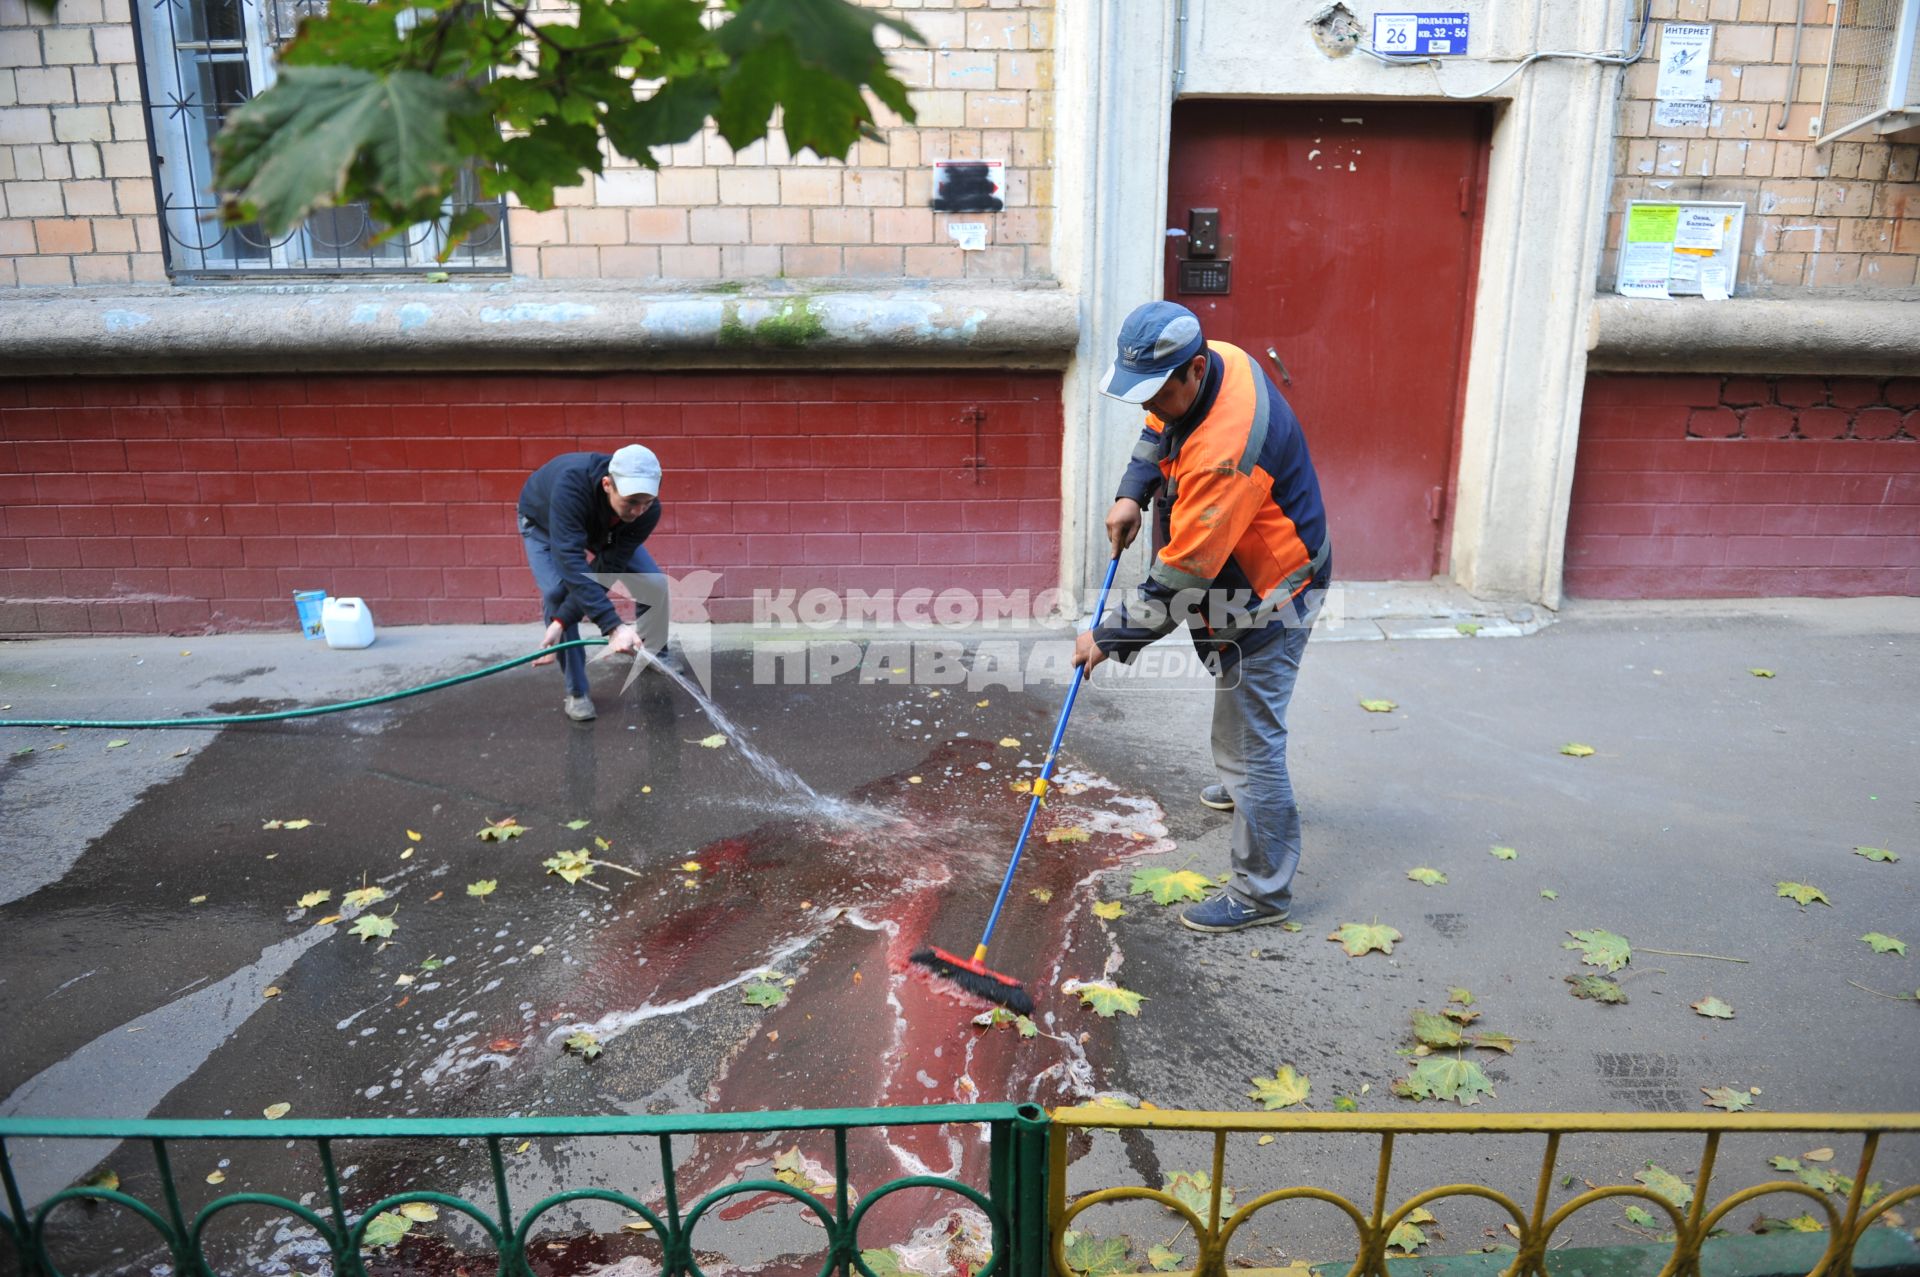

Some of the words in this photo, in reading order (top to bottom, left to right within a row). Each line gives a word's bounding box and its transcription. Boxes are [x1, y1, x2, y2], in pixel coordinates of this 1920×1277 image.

[1463, 16, 1468, 24] 2
[1434, 27, 1446, 37] 32
[1454, 27, 1467, 38] 56
[1665, 26, 1711, 35] ИНТЕРНЕТ
[1386, 28, 1407, 44] 26
